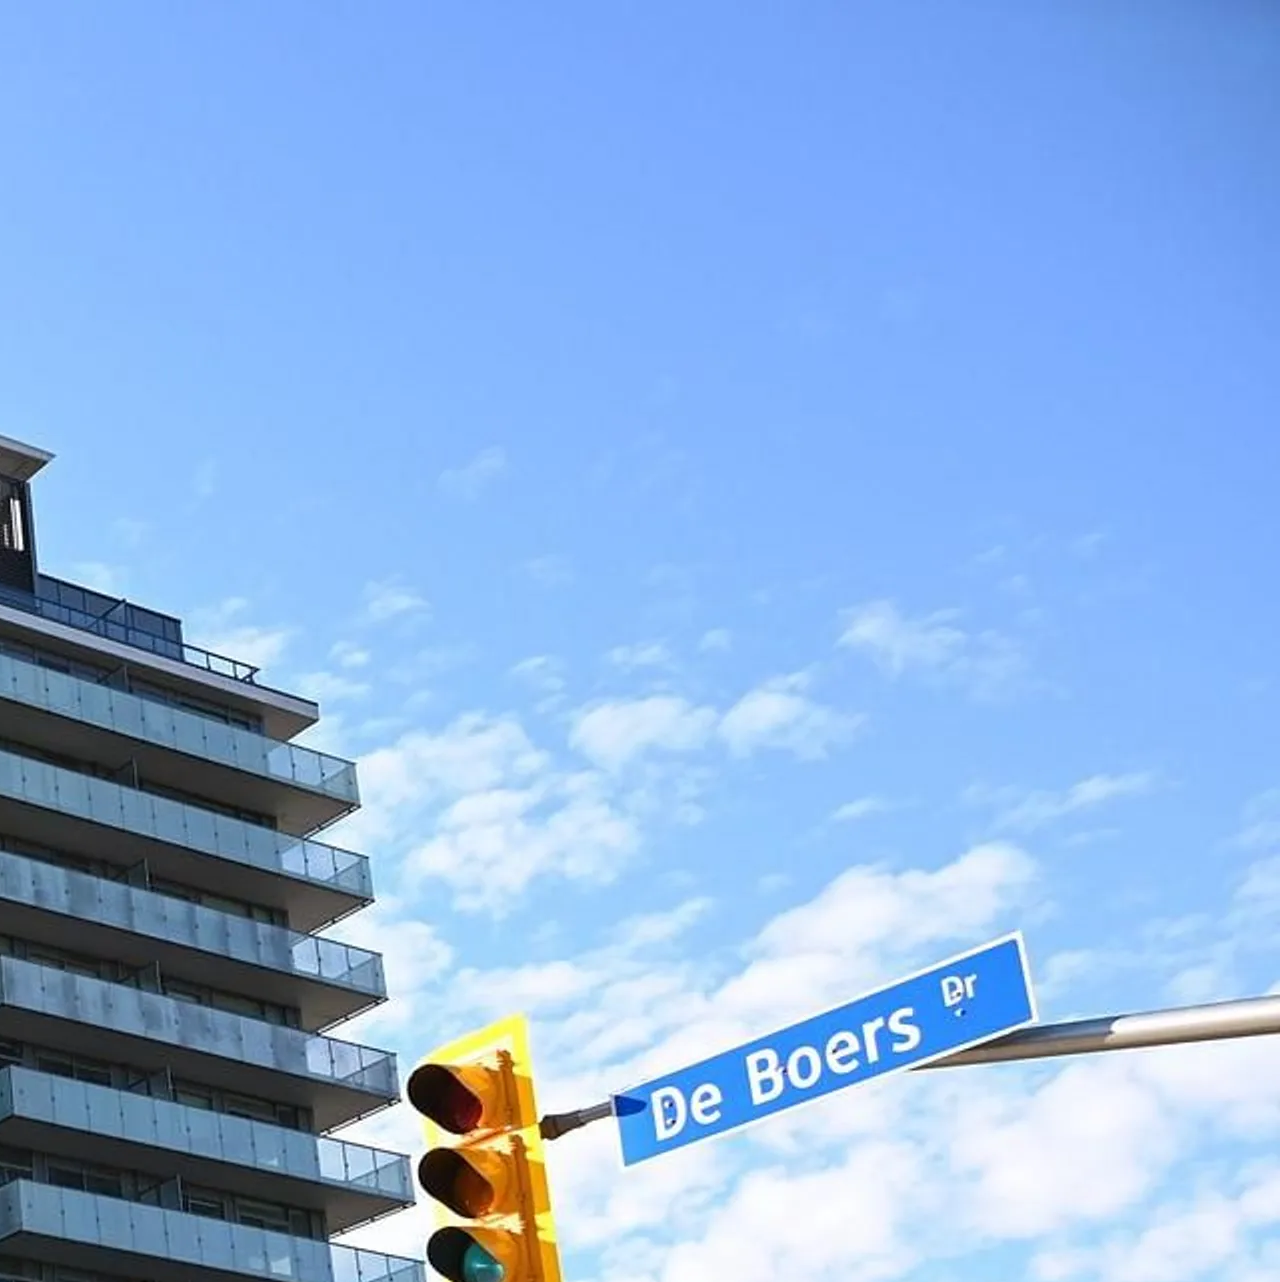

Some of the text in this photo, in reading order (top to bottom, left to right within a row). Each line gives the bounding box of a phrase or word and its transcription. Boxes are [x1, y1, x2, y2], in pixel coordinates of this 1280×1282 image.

[650, 973, 978, 1142] De Boers Dr
